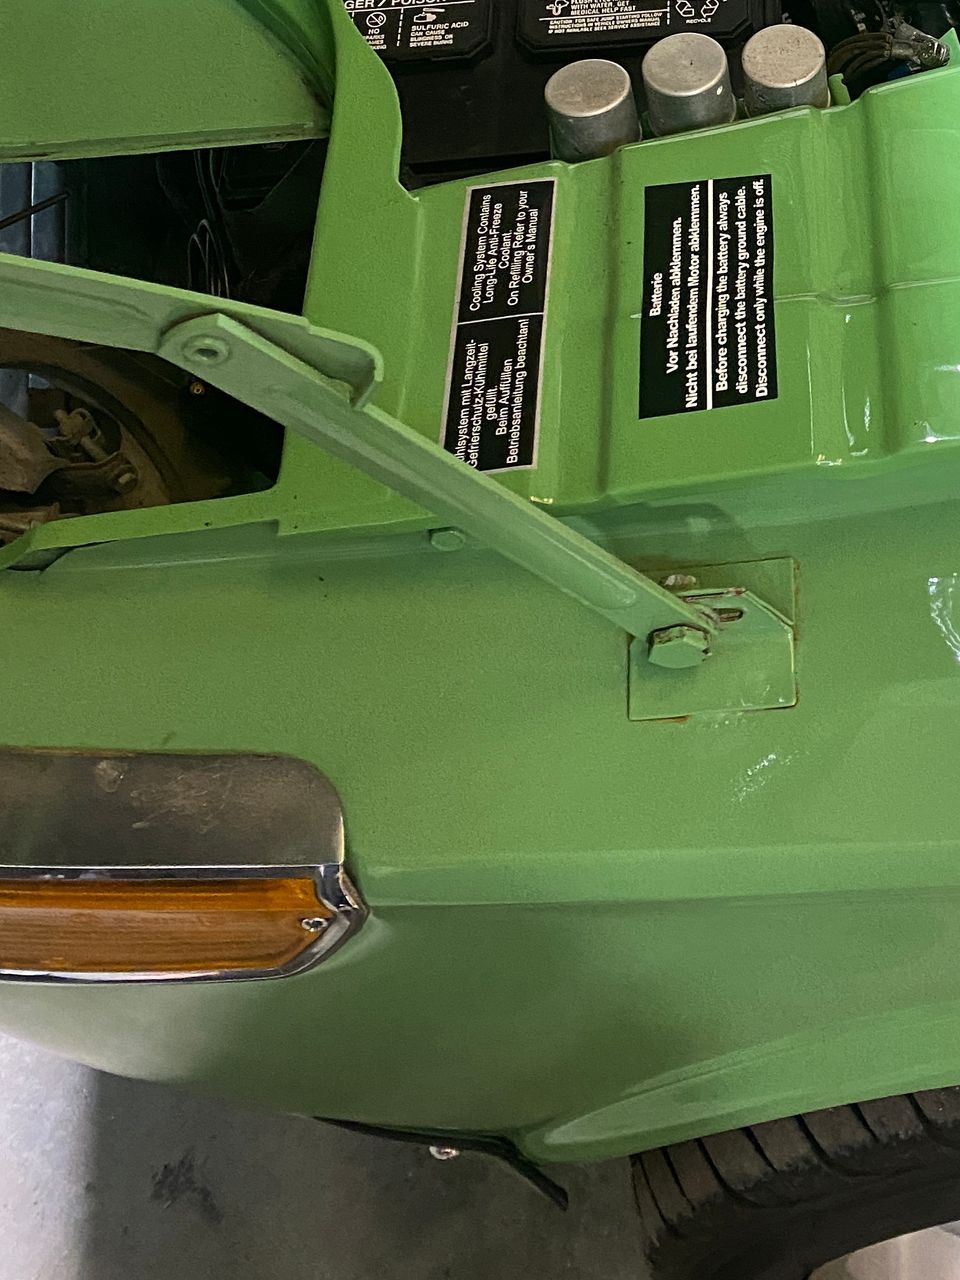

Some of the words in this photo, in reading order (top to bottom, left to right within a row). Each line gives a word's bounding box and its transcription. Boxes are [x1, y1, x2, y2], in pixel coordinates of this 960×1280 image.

[411, 22, 450, 32] SULFURIC
[451, 21, 469, 29] ACID
[570, 7, 600, 16] MEDICAL
[601, 6, 619, 14] HELP
[520, 190, 530, 209] your
[735, 186, 746, 219] cable.
[752, 179, 764, 196] off.
[753, 197, 764, 208] is
[477, 194, 492, 234] Contains
[488, 202, 503, 256] Anti-Freeze
[516, 211, 526, 221] to
[525, 208, 539, 242] Manual
[688, 184, 700, 252] abklemmen.
[717, 192, 731, 231] always
[754, 209, 768, 247] engine
[474, 235, 487, 272] System
[498, 229, 513, 269] Coolant.
[512, 222, 525, 248] Refer
[669, 217, 682, 287] abklemmen.
[717, 232, 731, 275] battery
[735, 221, 749, 261] ground
[509, 250, 525, 289] Refilling
[521, 243, 536, 284] Owner's
[687, 254, 700, 287] Motor
[754, 248, 766, 267] the
[469, 273, 486, 312] Cooling
[482, 258, 498, 304] Long-Life
[507, 290, 519, 306] On
[649, 272, 663, 316] Batterie
[716, 275, 728, 293] the
[734, 261, 750, 300] battery
[753, 268, 766, 296] while
[666, 288, 681, 348] Nachladen
[685, 287, 699, 348] laufendem
[715, 293, 730, 346] charging
[734, 301, 746, 320] the
[753, 297, 767, 322] only
[462, 339, 477, 388] Langzeit-
[666, 350, 679, 374] Vor
[685, 349, 698, 371] bei
[715, 347, 728, 392] Before
[735, 321, 749, 394] disconnect
[754, 323, 768, 398] Disconnect
[461, 389, 473, 406] mit
[685, 372, 698, 408] Nicht
[455, 407, 470, 462] hlsystem
[495, 407, 509, 436] Beim
[506, 371, 527, 464] Betriebsanleitung
